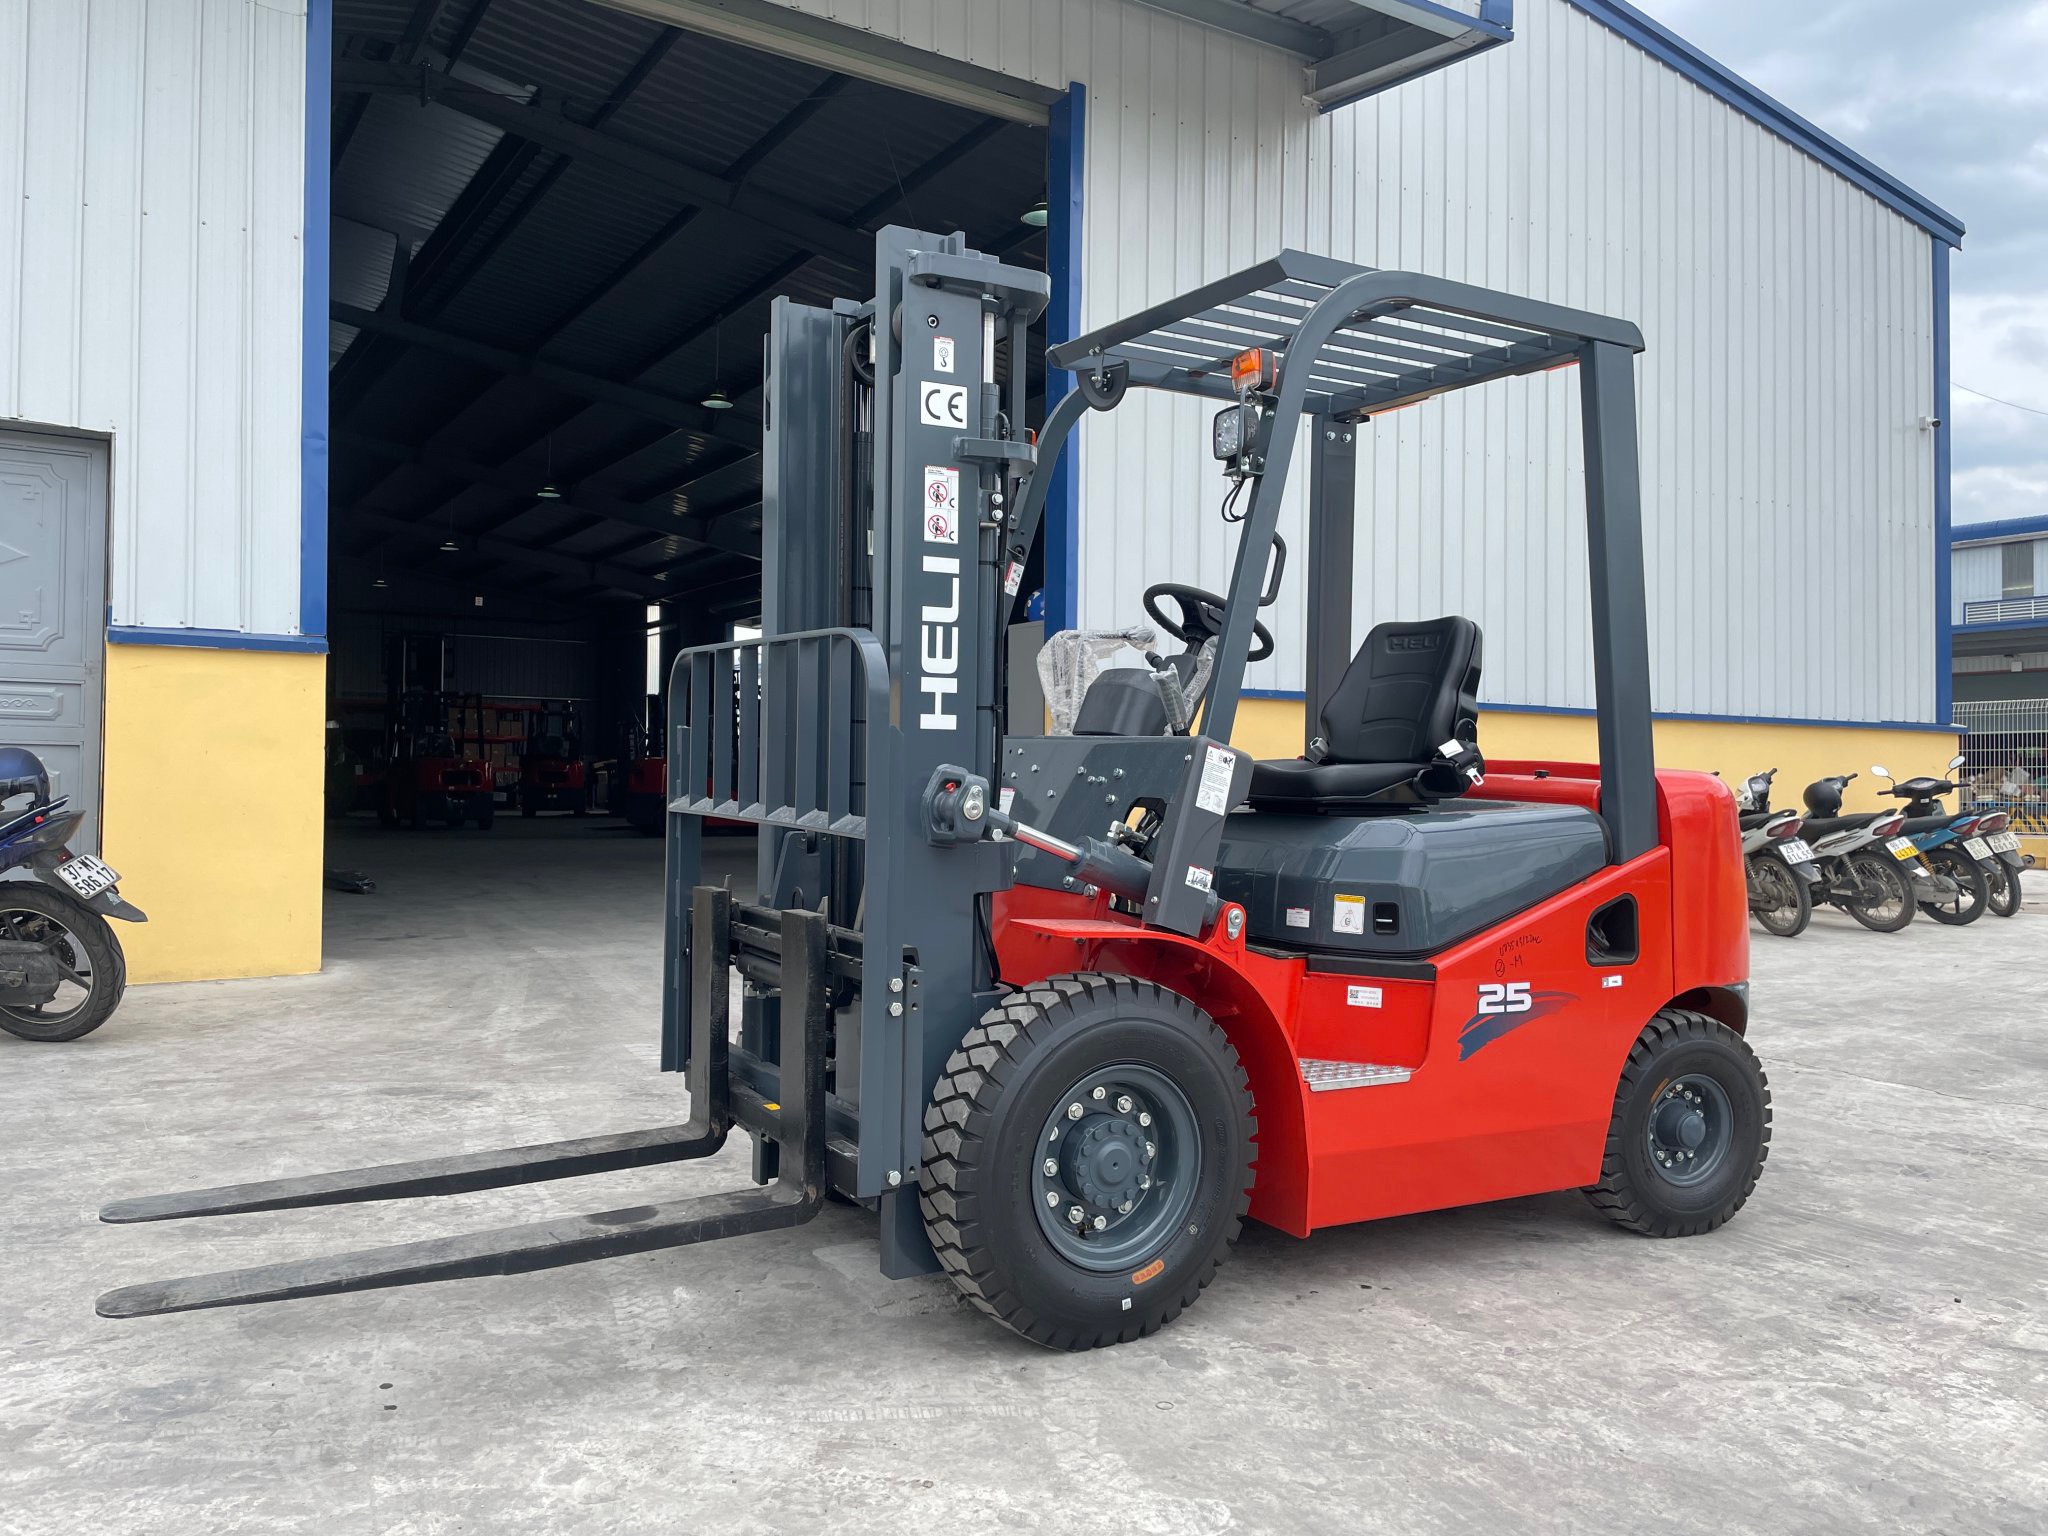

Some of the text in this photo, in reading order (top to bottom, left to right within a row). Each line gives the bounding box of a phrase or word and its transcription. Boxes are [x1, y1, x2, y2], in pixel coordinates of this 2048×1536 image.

[925, 389, 963, 423] CE
[920, 555, 960, 730] HELI
[1391, 636, 1440, 650] HELI
[75, 867, 115, 895] 586.17
[1479, 982, 1532, 1014] 25
